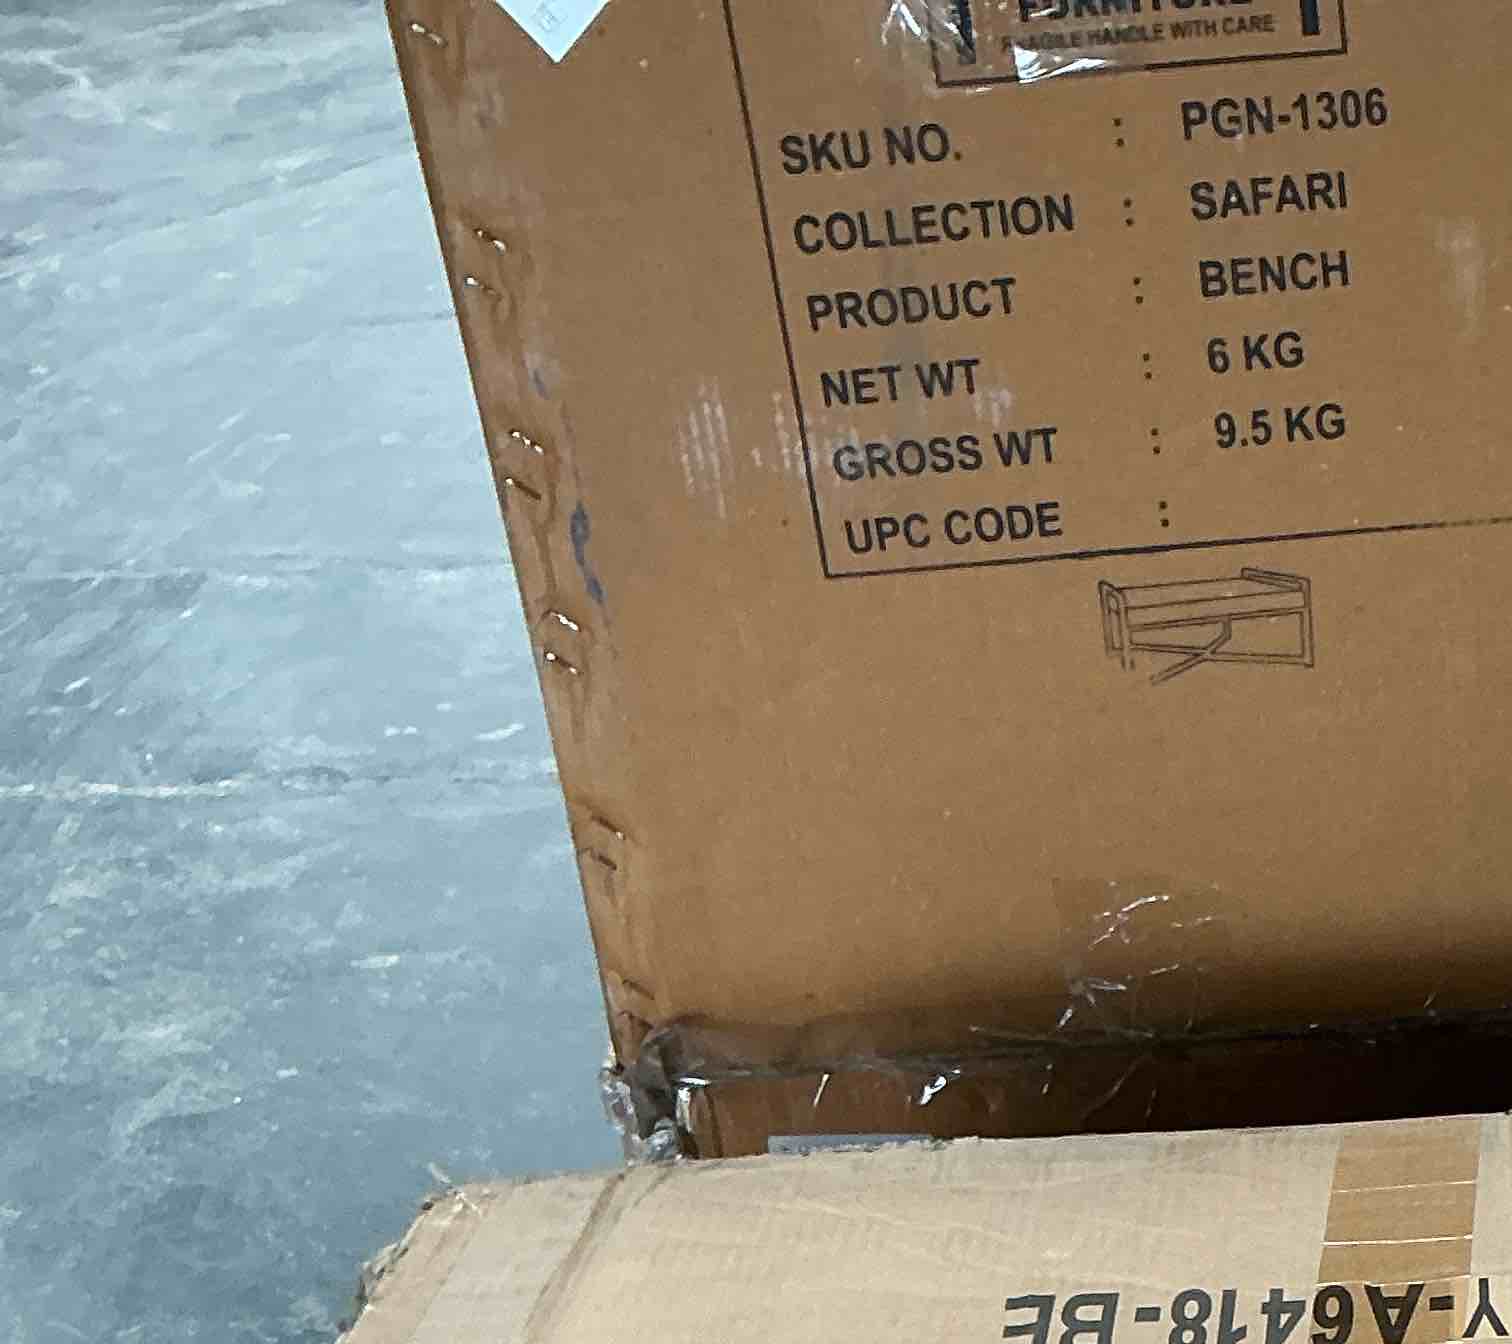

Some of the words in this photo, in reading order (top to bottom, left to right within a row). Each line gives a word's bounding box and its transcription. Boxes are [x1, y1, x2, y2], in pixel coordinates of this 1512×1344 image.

[1170, 18, 1218, 40] WITH
[1221, 14, 1276, 36] CARE
[780, 129, 870, 176] SKU
[885, 121, 962, 167] NO.
[1181, 88, 1388, 141] PGN-1306
[793, 195, 1074, 254] COLLECTION
[1190, 171, 1350, 221] SAFARI
[806, 279, 1017, 332] PRODUCT
[1199, 250, 1351, 298] BENCH
[820, 366, 903, 408] NET
[914, 359, 980, 399] WT
[1208, 337, 1231, 374] 6
[1243, 331, 1305, 371] KG
[832, 434, 983, 482] GROSS
[993, 428, 1058, 467] WT
[1213, 410, 1273, 450] 9.5
[1284, 402, 1347, 443] KG
[845, 511, 932, 555] UPC
[944, 503, 1064, 546] CODE
